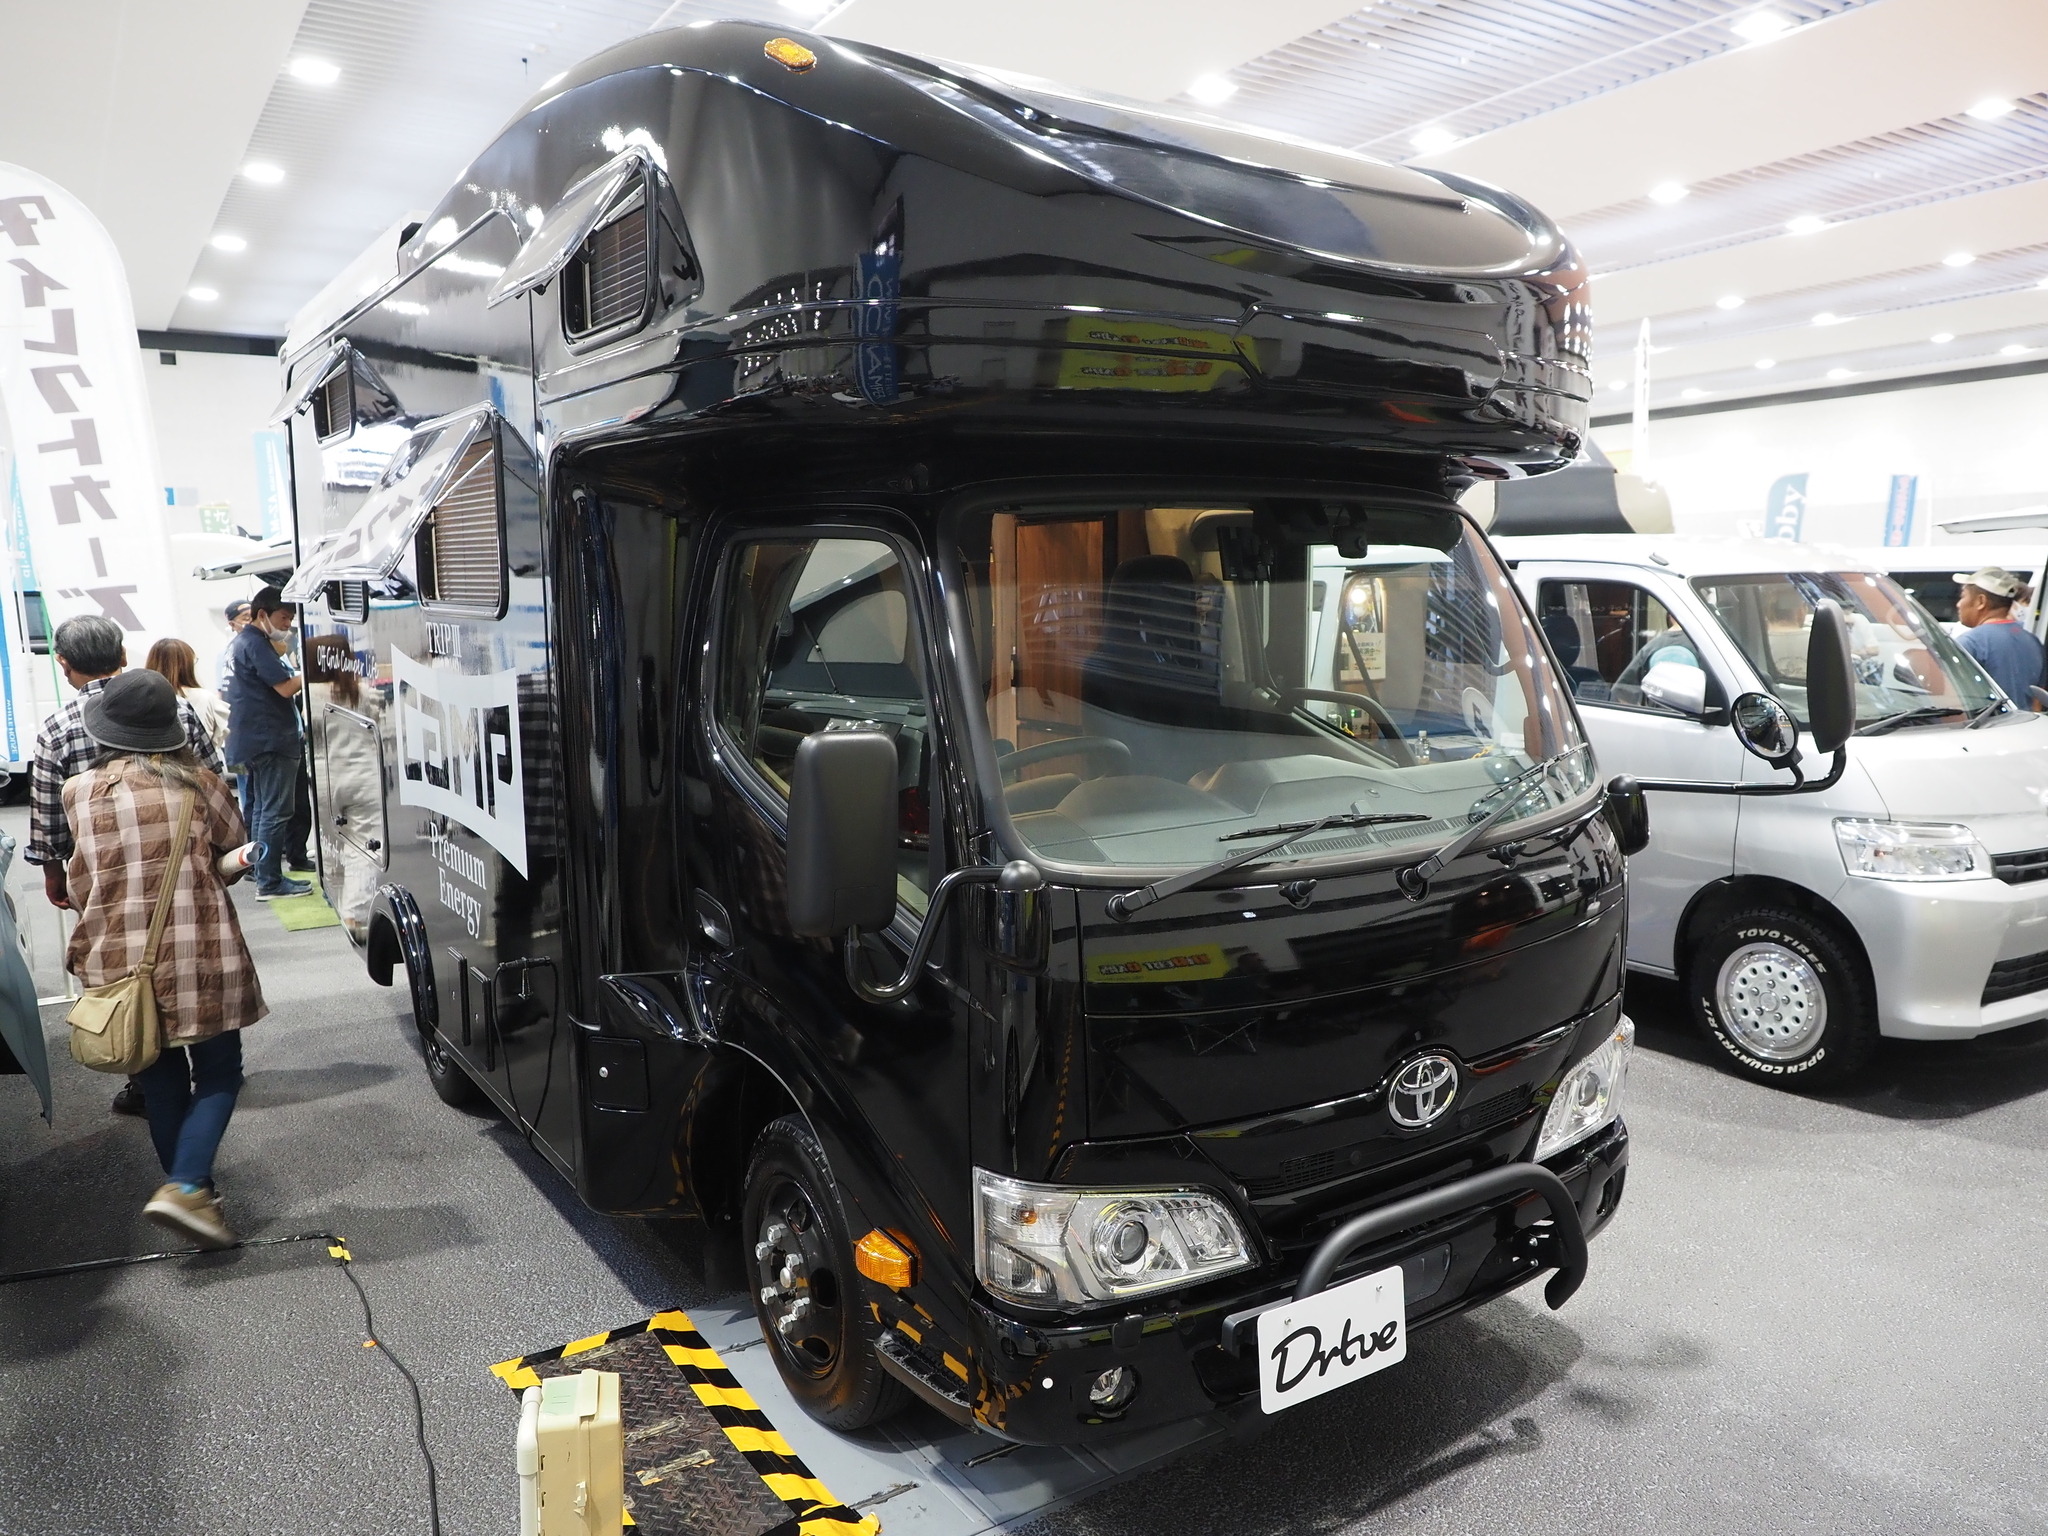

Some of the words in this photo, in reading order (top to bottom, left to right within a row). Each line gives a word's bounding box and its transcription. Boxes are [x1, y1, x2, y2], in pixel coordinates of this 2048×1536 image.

[316, 645, 326, 673] Off
[326, 645, 341, 671] Grid
[340, 649, 365, 682] Camper
[365, 653, 380, 688] Life
[430, 821, 487, 890] Premium
[438, 866, 482, 939] Energy
[1737, 927, 1780, 940] TOYO
[1783, 933, 1828, 974] TIRES
[1702, 996, 1719, 1029] R/T
[1714, 1030, 1784, 1076] COUNTRY
[1786, 1047, 1827, 1075] OPEN
